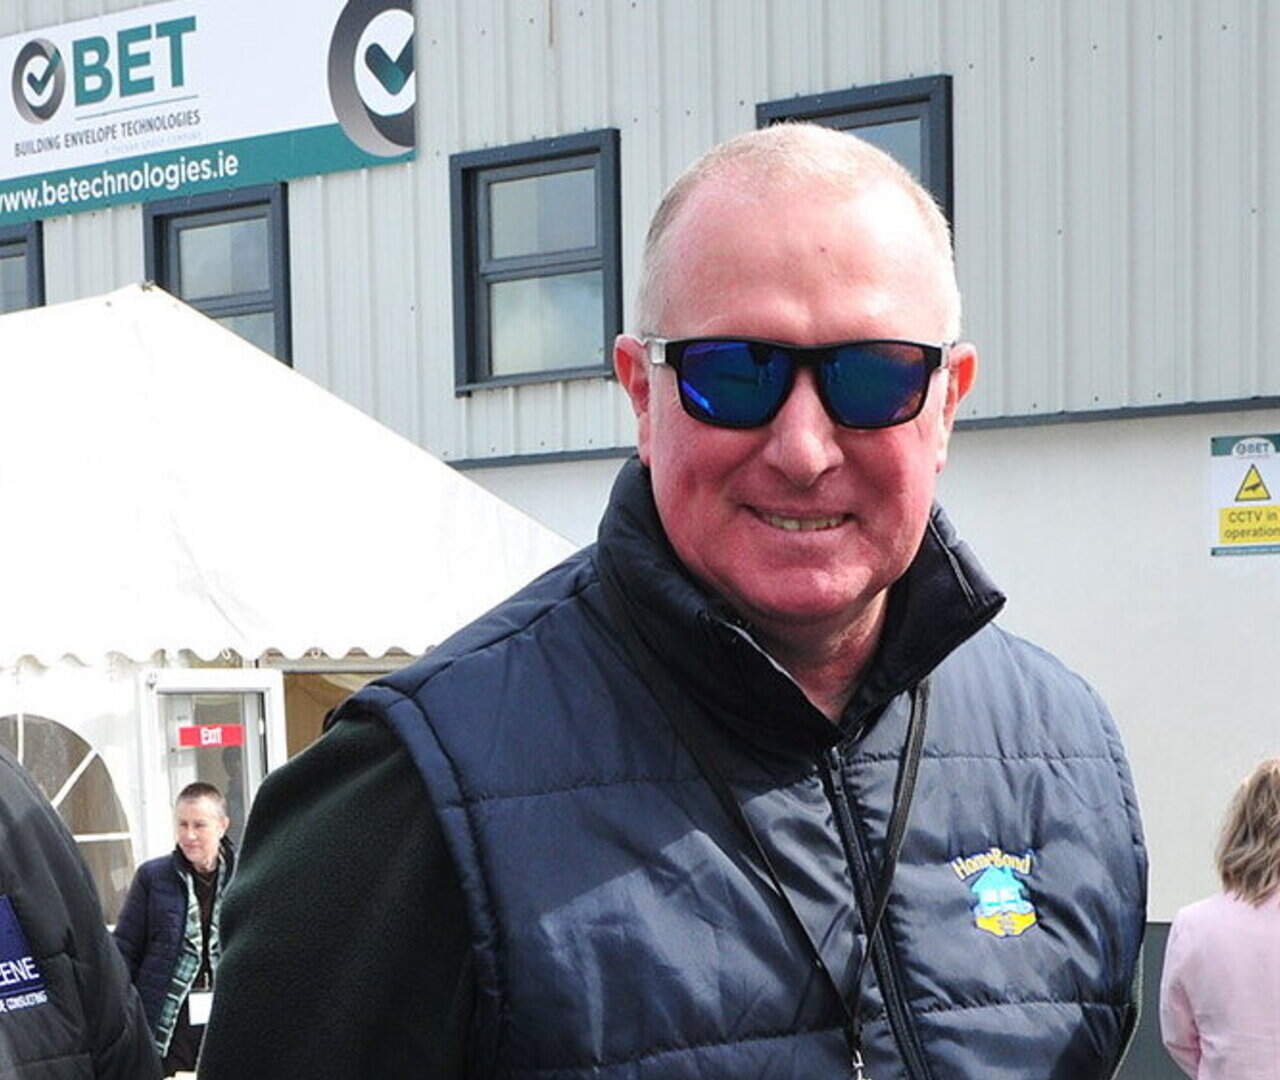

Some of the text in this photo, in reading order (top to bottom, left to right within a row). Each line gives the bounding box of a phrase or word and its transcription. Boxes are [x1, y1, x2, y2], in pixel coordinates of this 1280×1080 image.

[72, 15, 197, 107] BET
[14, 134, 60, 157] BUILDING
[64, 124, 117, 148] ENVELOPE
[121, 109, 201, 137] TECHNOLOGIES
[1228, 510, 1278, 523] CCTV in
[200, 727, 223, 745] Exit
